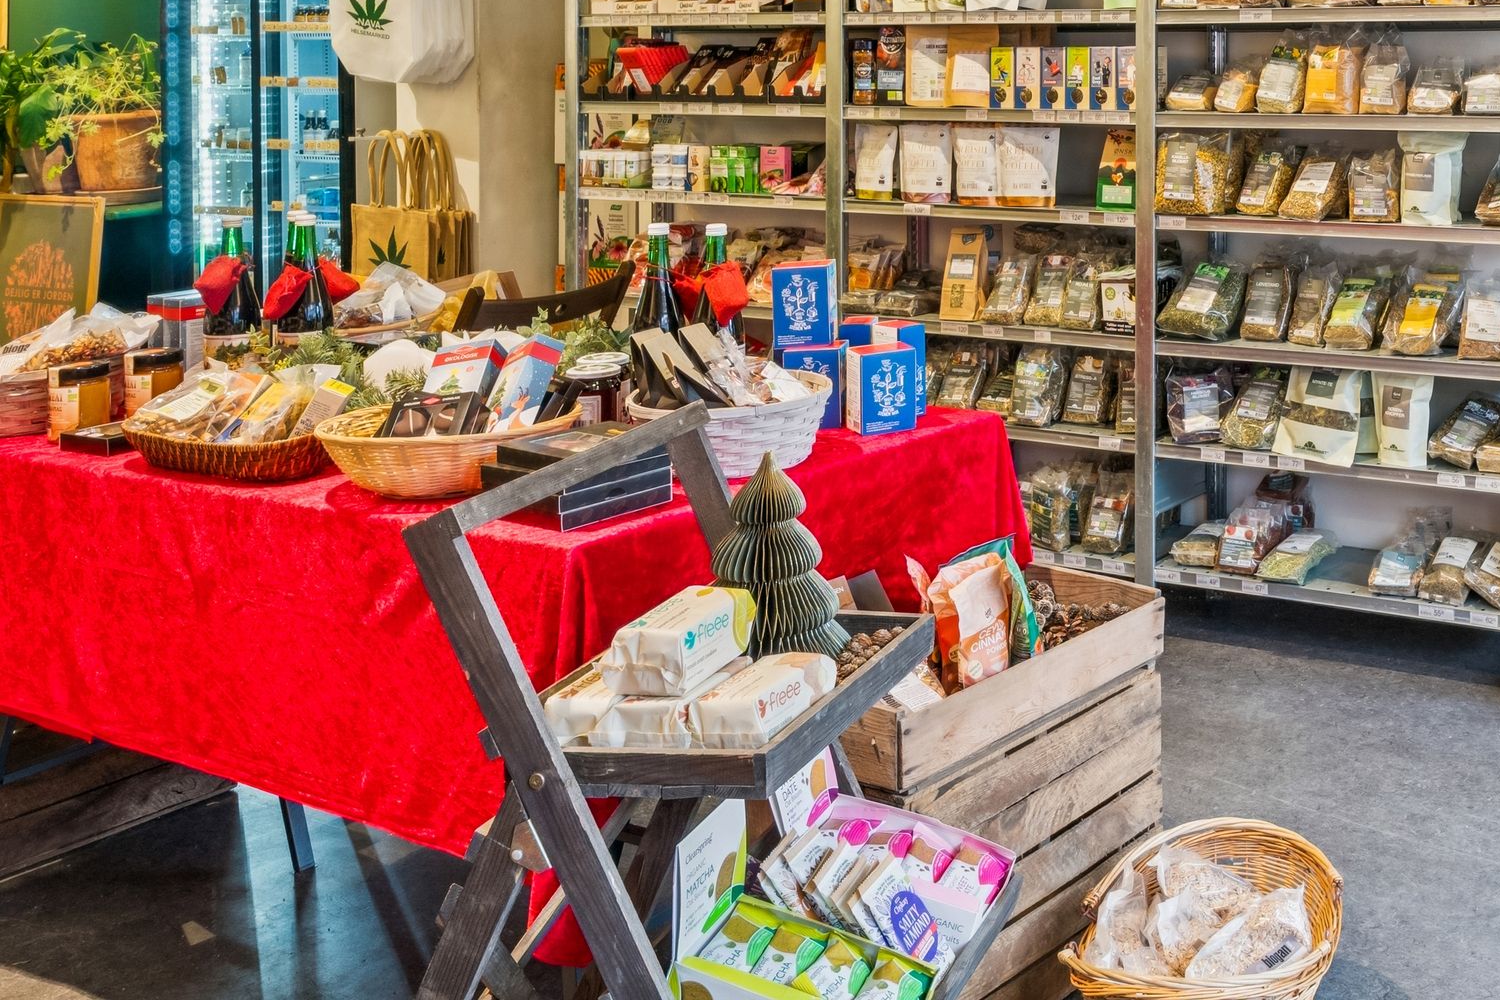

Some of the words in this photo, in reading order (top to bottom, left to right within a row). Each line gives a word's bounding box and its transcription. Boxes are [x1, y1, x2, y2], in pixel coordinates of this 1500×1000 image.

[351, 28, 390, 39] HELSEMARKED
[357, 18, 383, 30] NAVA
[5, 288, 30, 297] DEJLIG
[32, 289, 40, 299] ER
[43, 291, 74, 301] JORDEN
[444, 352, 478, 362] ØKOLOGISK
[696, 613, 729, 644] freee
[769, 681, 801, 712] freee
[782, 782, 798, 801] DATE
[685, 832, 713, 865] Clearspring
[686, 858, 707, 881] ORGANIC
[686, 864, 715, 896] MATCHA
[898, 904, 922, 933] SALTY
[903, 912, 931, 951] ALMOND
